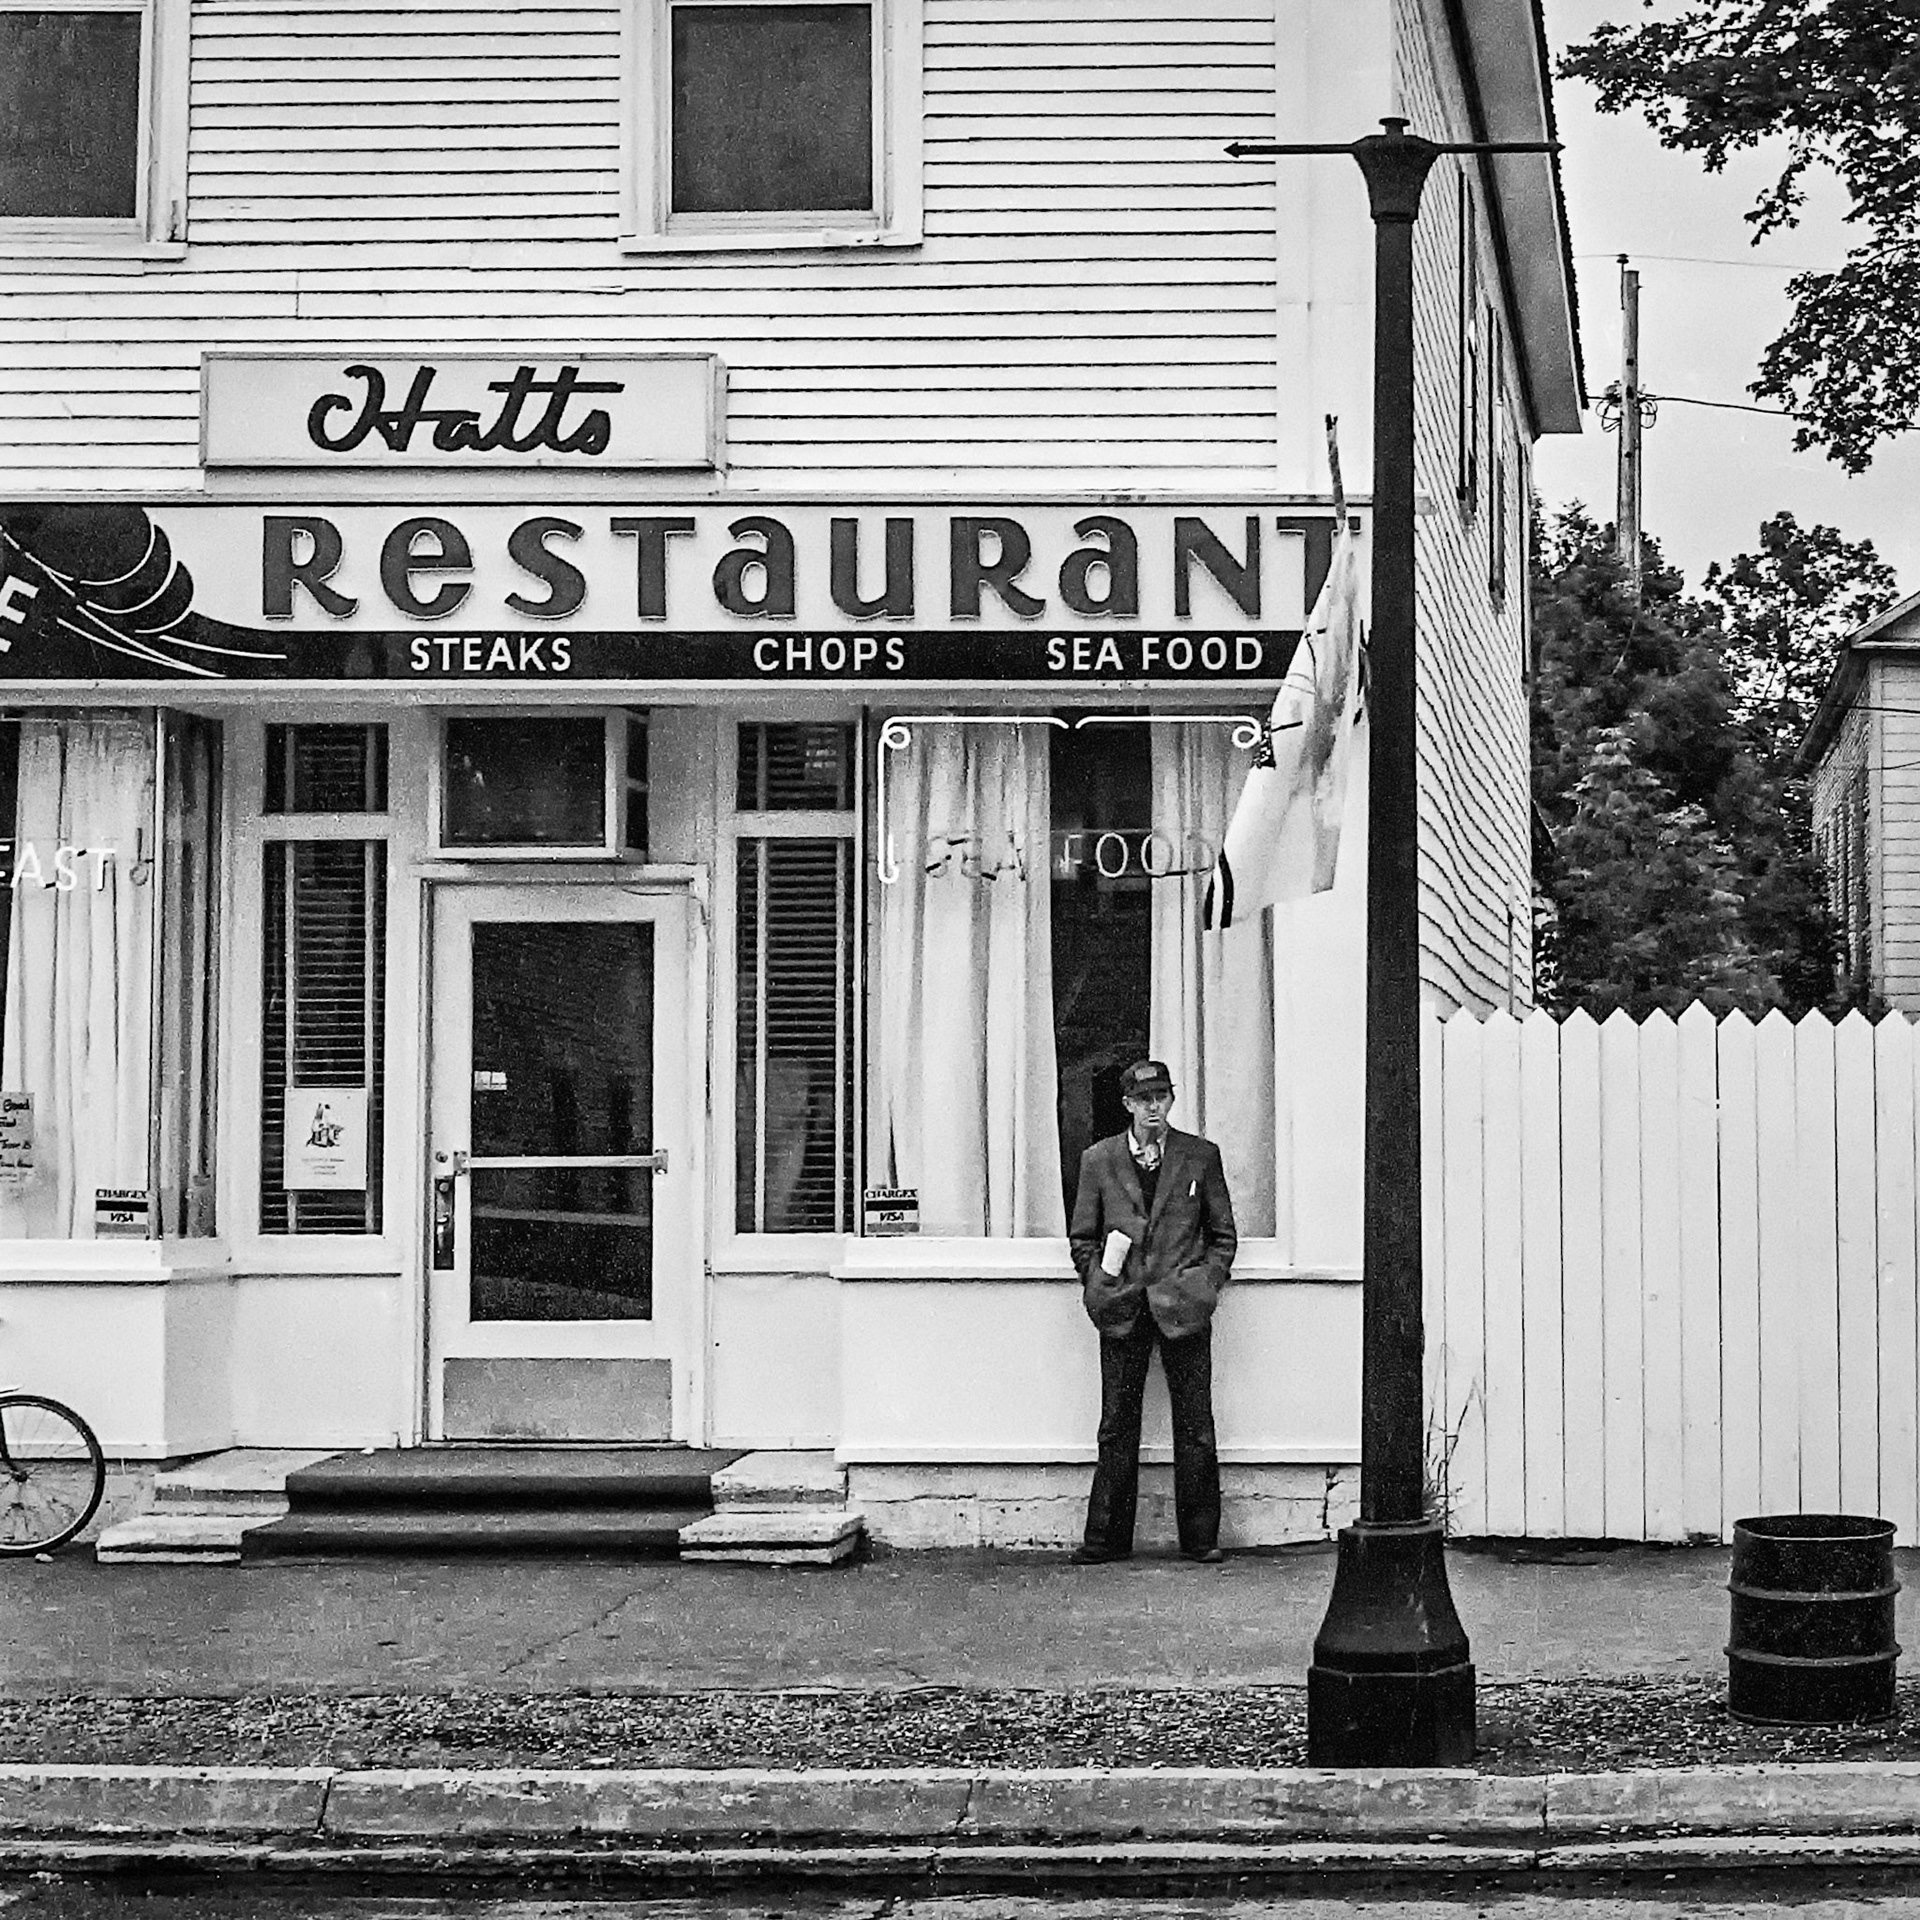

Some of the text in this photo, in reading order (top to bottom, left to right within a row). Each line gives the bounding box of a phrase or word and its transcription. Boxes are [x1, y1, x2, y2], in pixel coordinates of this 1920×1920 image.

[308, 364, 624, 455] Hatts
[409, 637, 572, 672] STEAKS
[753, 637, 905, 672] CHOPS
[1047, 637, 1263, 671] SEA FOOD
[110, 1212, 134, 1222] VISA
[880, 1211, 904, 1221] VISA
